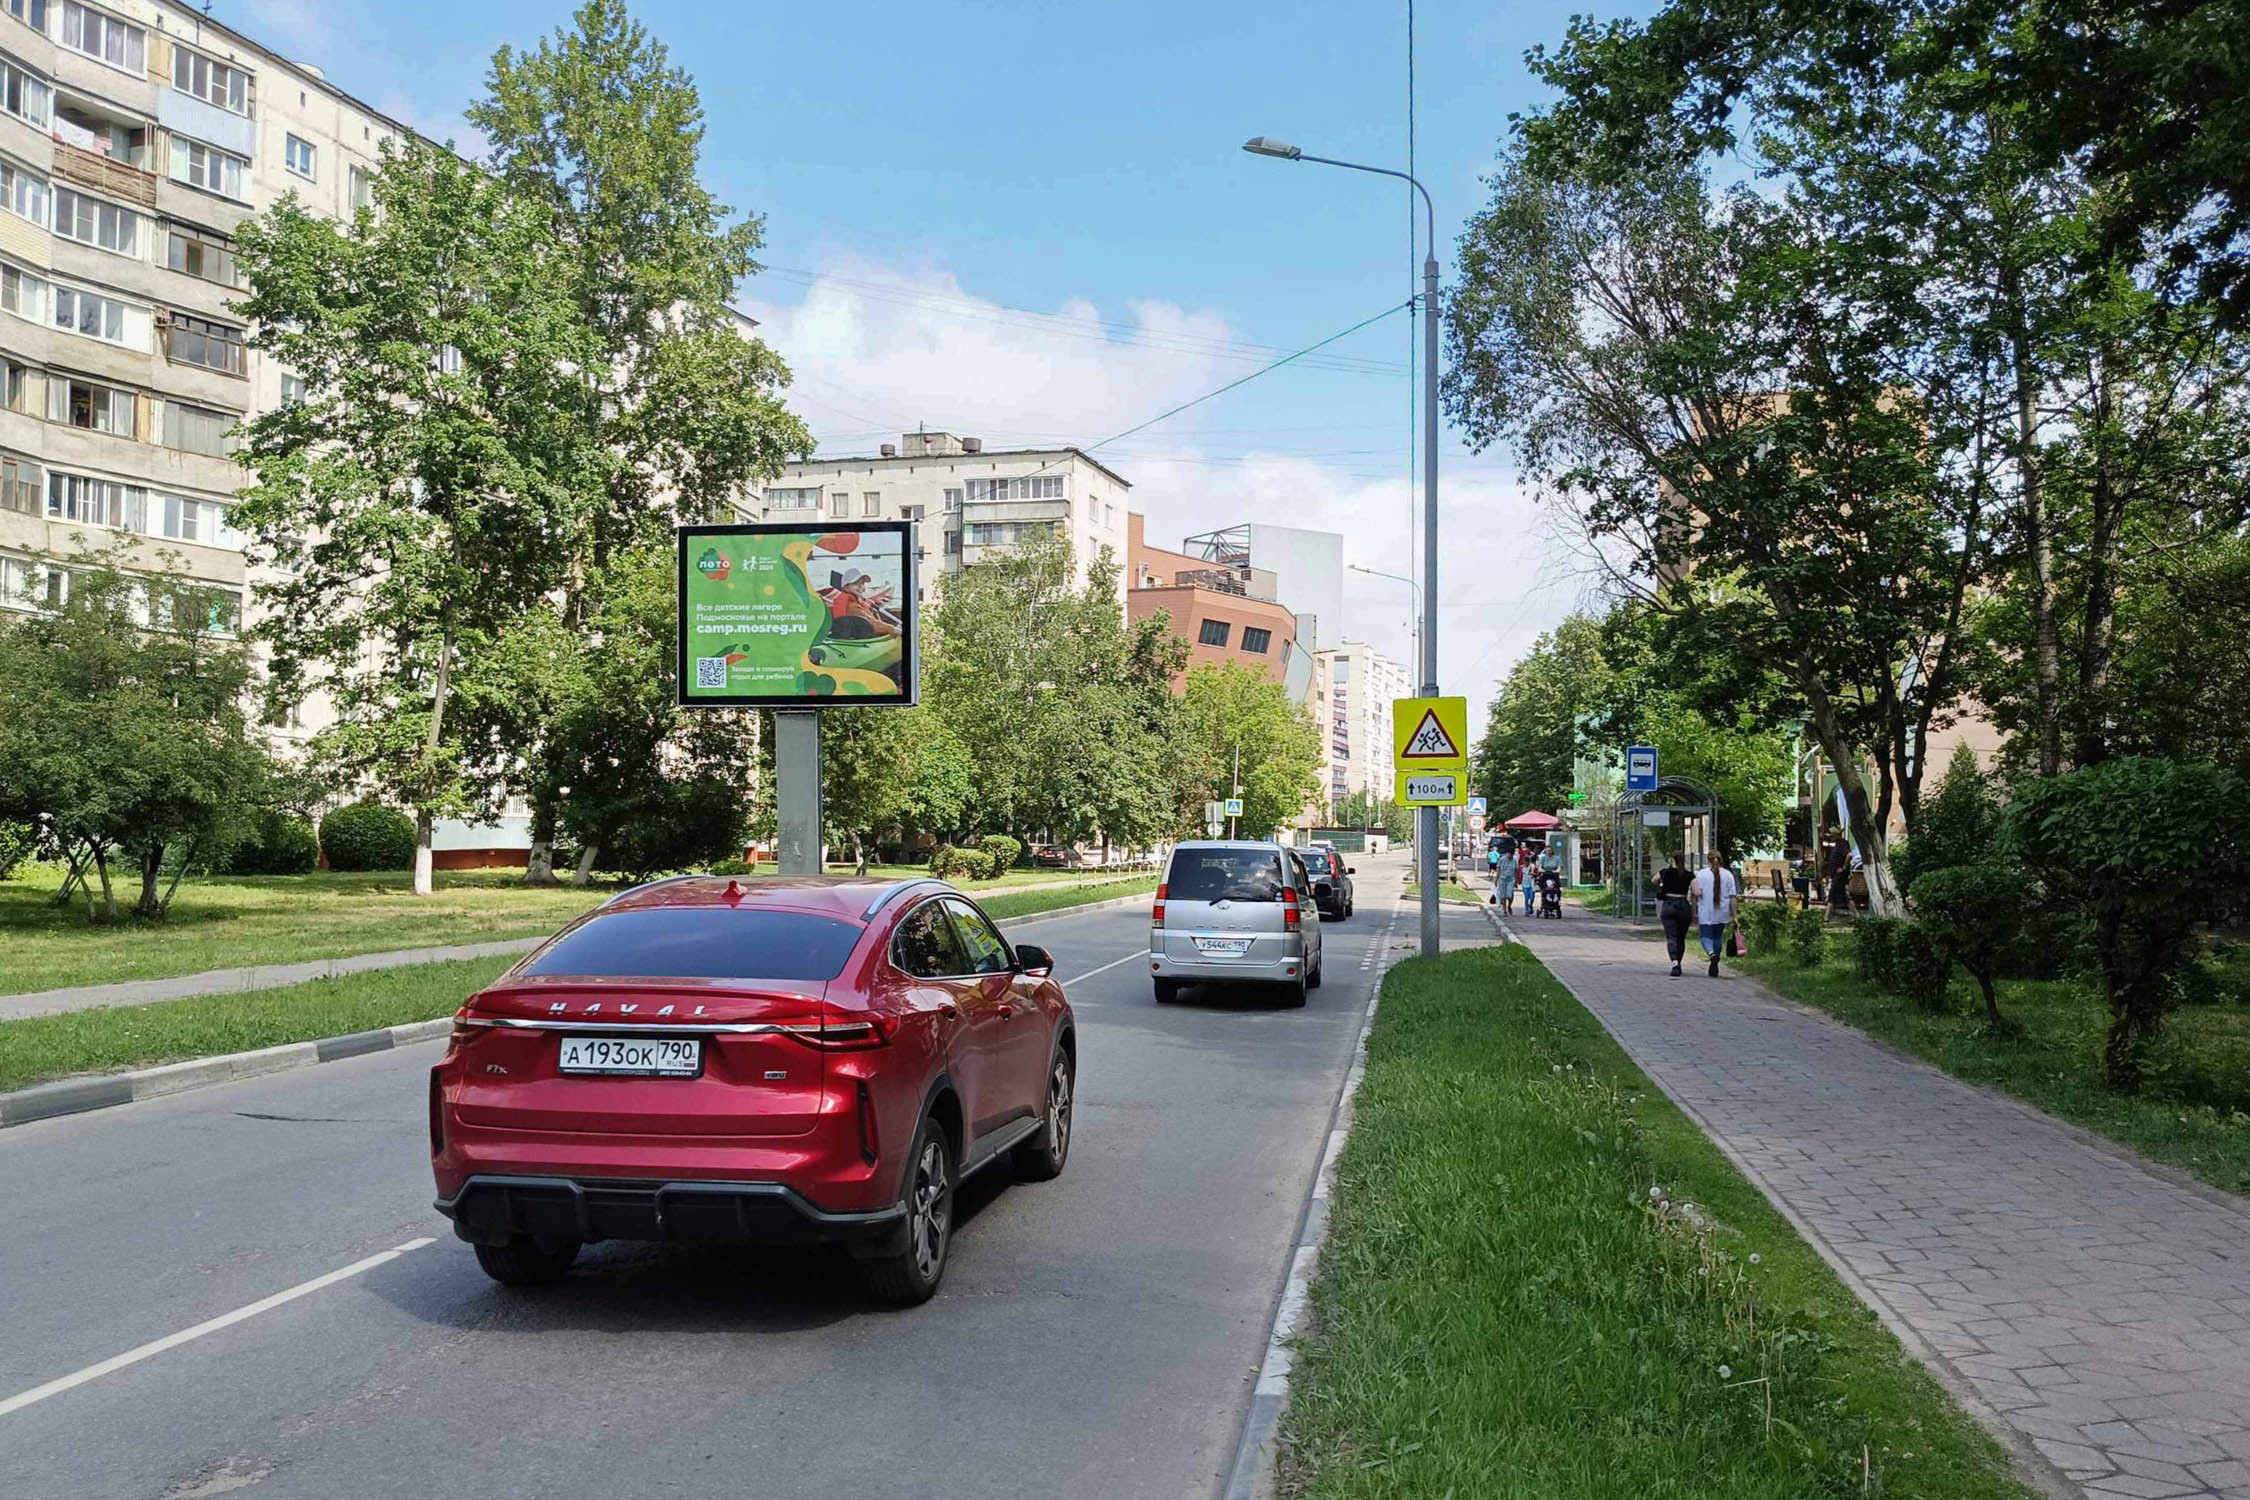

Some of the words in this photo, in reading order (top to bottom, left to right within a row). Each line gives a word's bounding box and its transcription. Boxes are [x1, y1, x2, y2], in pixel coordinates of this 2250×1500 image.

[770, 614, 807, 622] портале
[697, 624, 807, 635] camp.mosreg.ru
[549, 1002, 706, 1017] HAVAL
[659, 1041, 693, 1060] 790
[666, 1060, 683, 1068] RUS
